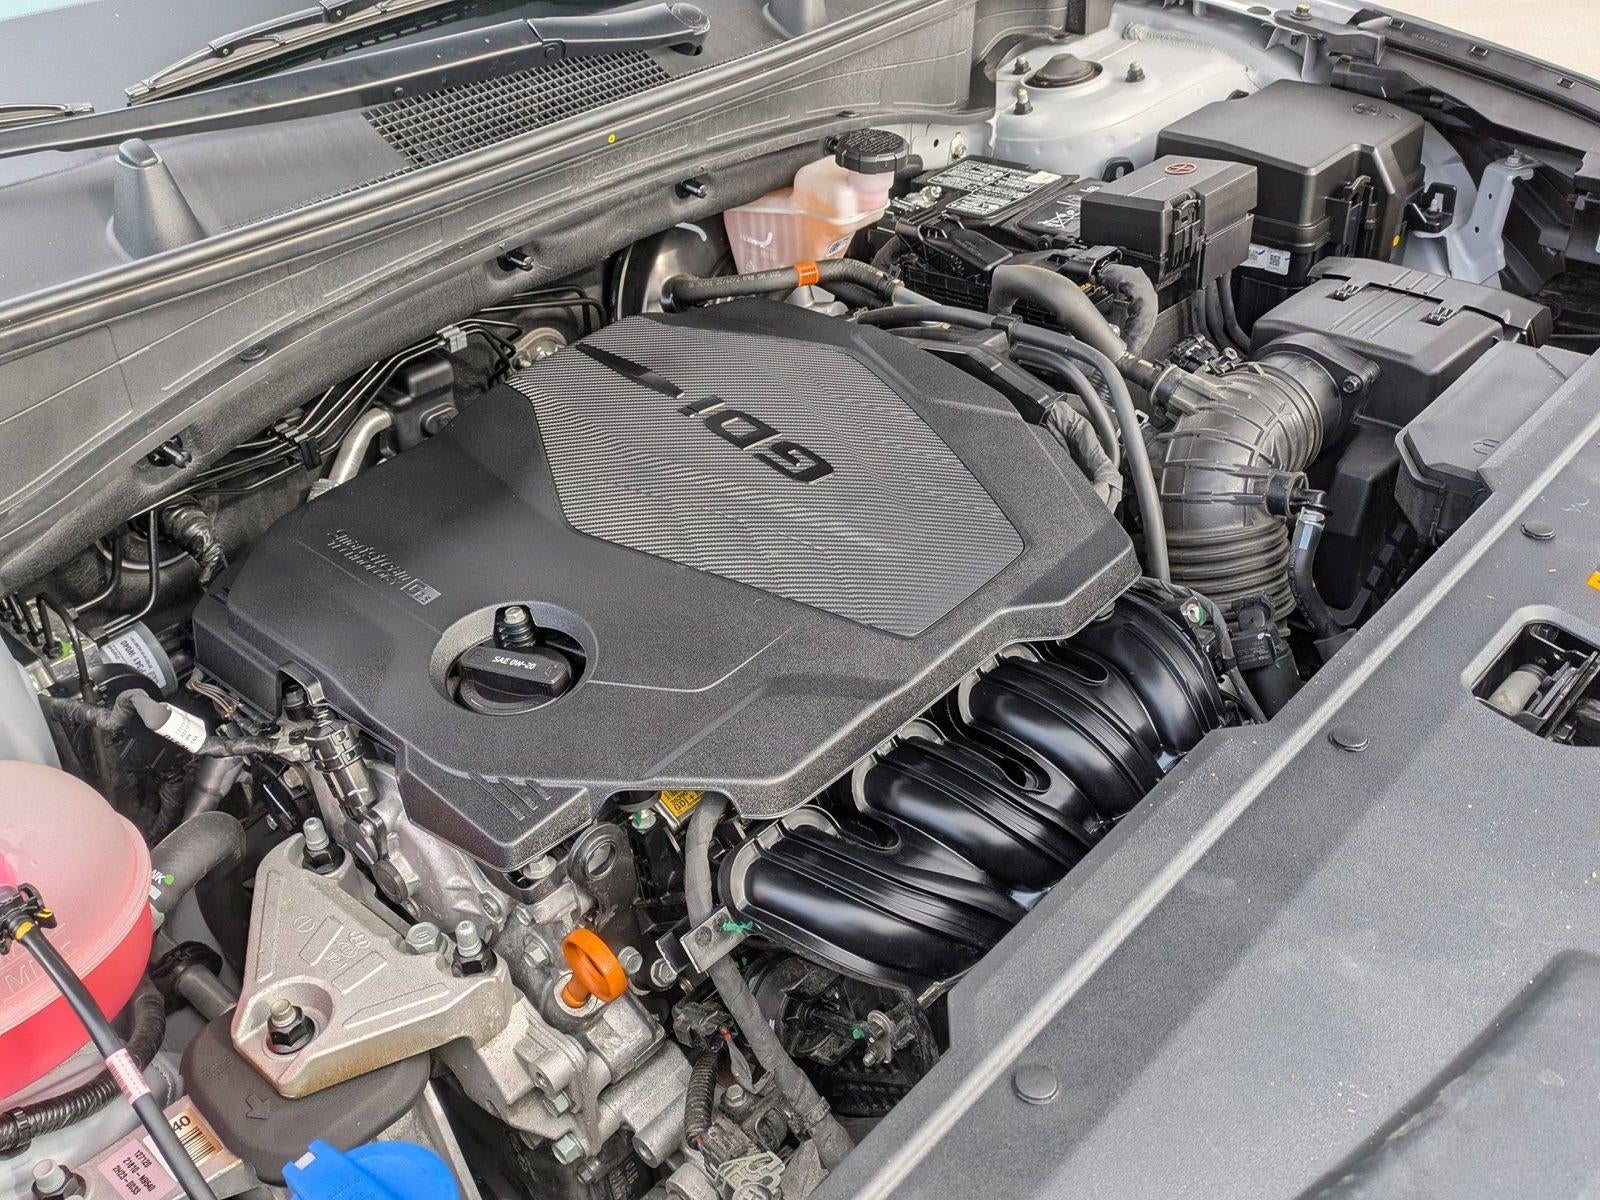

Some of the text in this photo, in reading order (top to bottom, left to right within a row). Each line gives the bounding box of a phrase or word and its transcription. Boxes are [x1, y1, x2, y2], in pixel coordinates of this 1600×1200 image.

[492, 655, 537, 671] SAE 0W-20
[674, 798, 689, 811] GDI
[133, 1149, 153, 1169] 127120
